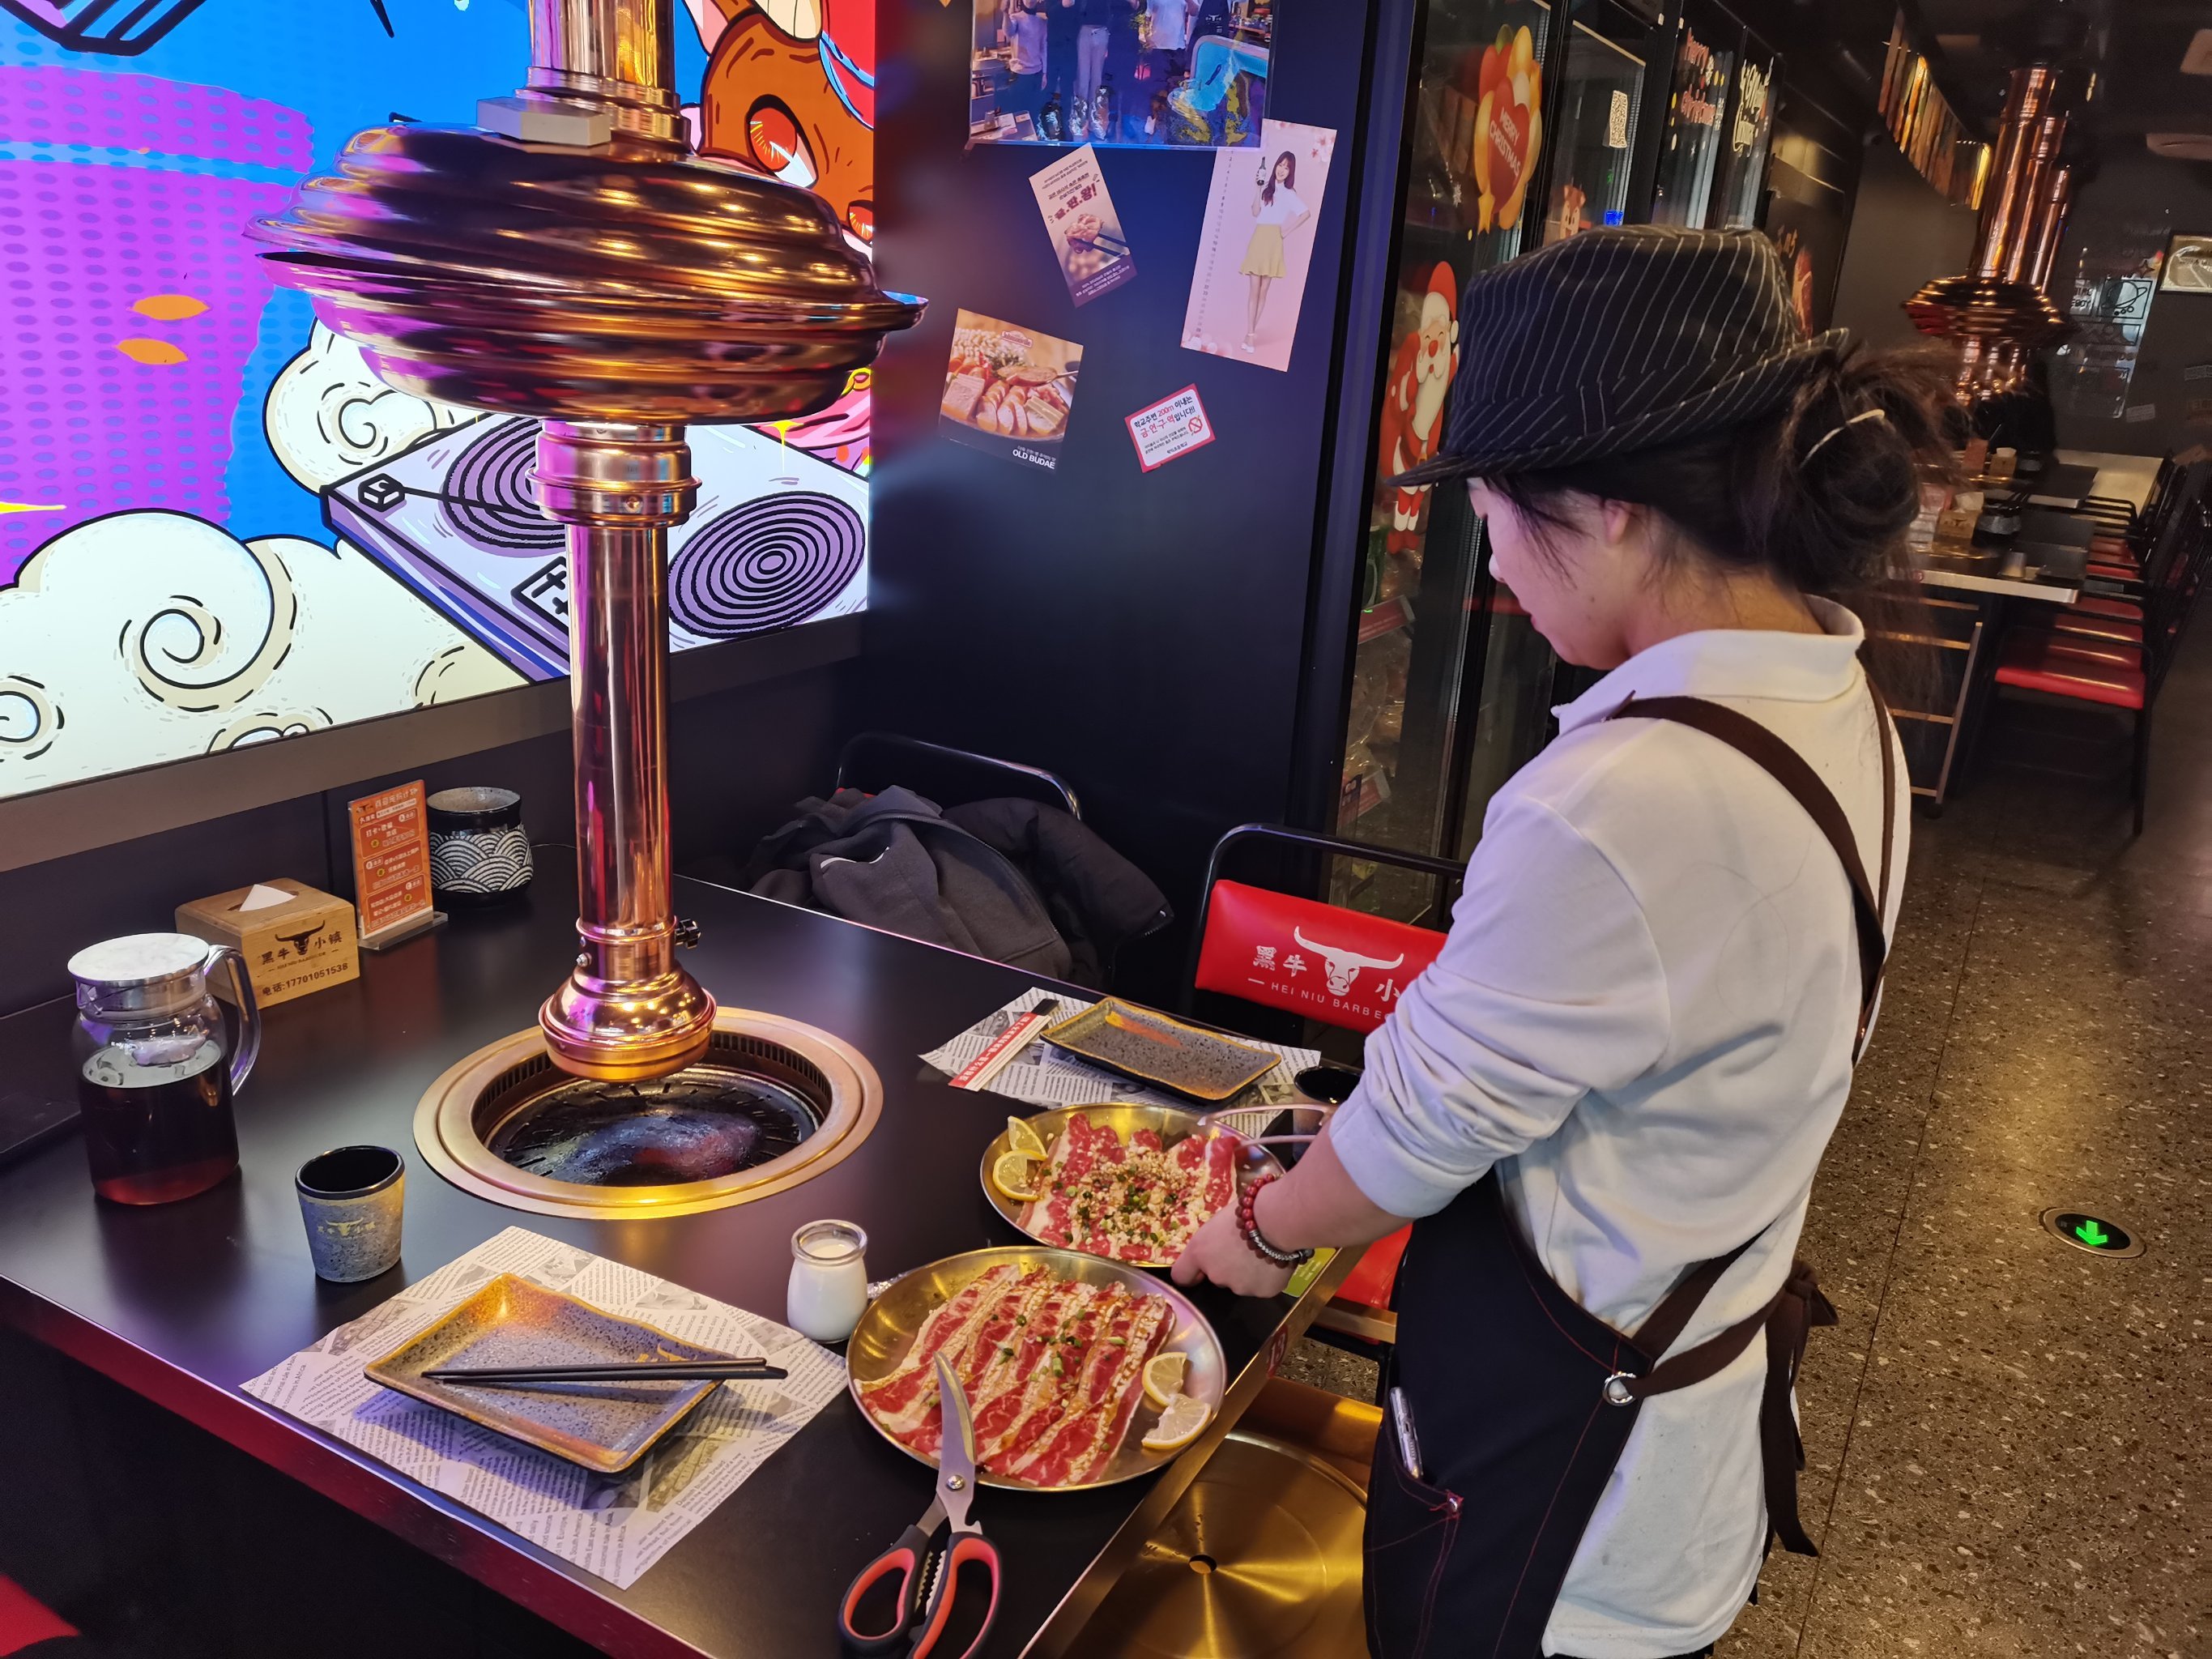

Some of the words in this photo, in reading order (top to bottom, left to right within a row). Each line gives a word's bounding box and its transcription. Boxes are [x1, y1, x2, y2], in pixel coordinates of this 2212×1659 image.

[1499, 106, 1520, 147] MERRY
[1490, 120, 1521, 177] CHRISTMAS
[1134, 412, 1158, 428] 학교주변
[1157, 405, 1174, 417] 200m
[1174, 396, 1193, 407] 이내는
[1012, 449, 1028, 459] OLD
[1029, 454, 1055, 469] BUDAE
[262, 948, 291, 965] 黑牛
[262, 962, 348, 996] 电话:17701051538
[1253, 945, 1307, 977] 黑牛
[1375, 979, 1400, 1002] 小
[1272, 982, 1294, 996] HEI
[1302, 990, 1325, 1003] NIU
[324, 1361, 343, 1375] around
